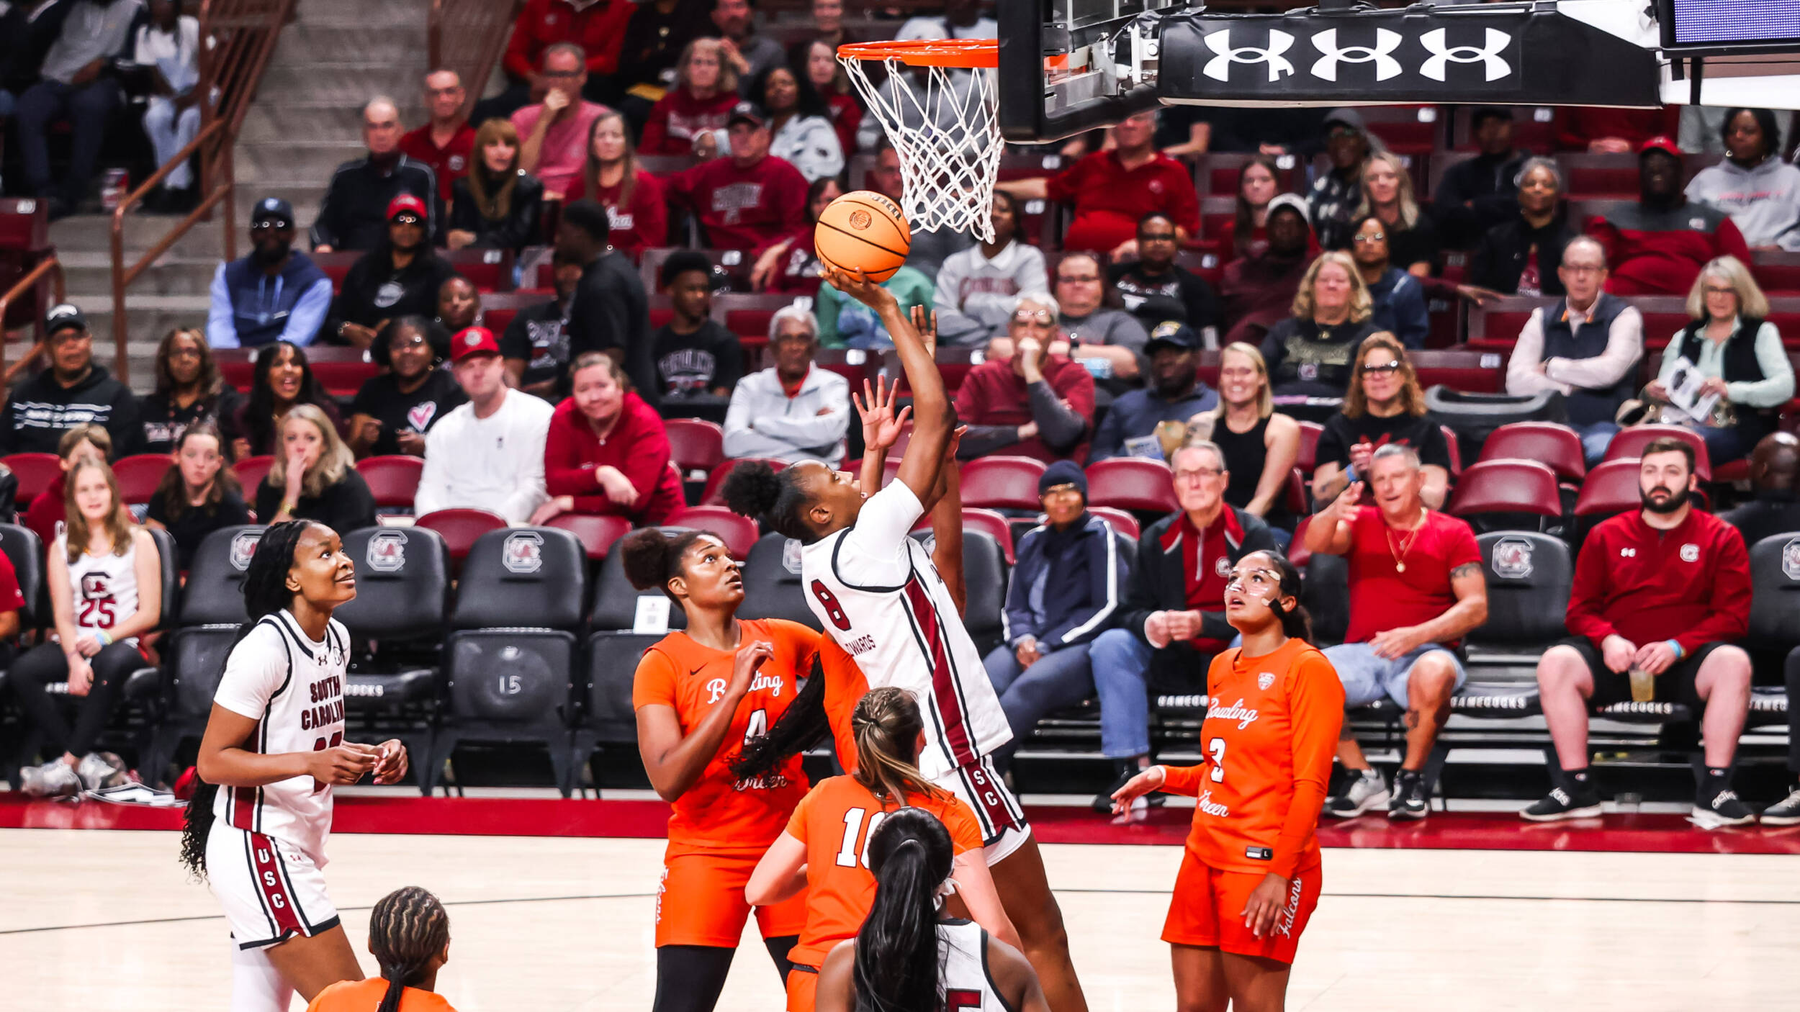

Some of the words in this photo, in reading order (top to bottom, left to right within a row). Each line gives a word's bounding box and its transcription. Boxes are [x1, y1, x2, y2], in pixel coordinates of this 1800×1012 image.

[79, 599, 116, 629] 25
[811, 579, 852, 631] 8
[845, 634, 876, 657] DWARDS
[310, 675, 341, 703] SOUTH
[344, 684, 384, 697] COCKS
[499, 675, 522, 694] 15
[706, 670, 783, 704] Bling
[301, 701, 344, 731] CAROLIN
[1157, 695, 1209, 707] GAMECO
[1205, 698, 1259, 730] Bowling
[1208, 736, 1227, 783] 3
[973, 770, 998, 806] SC
[1276, 878, 1302, 939] Falcons
